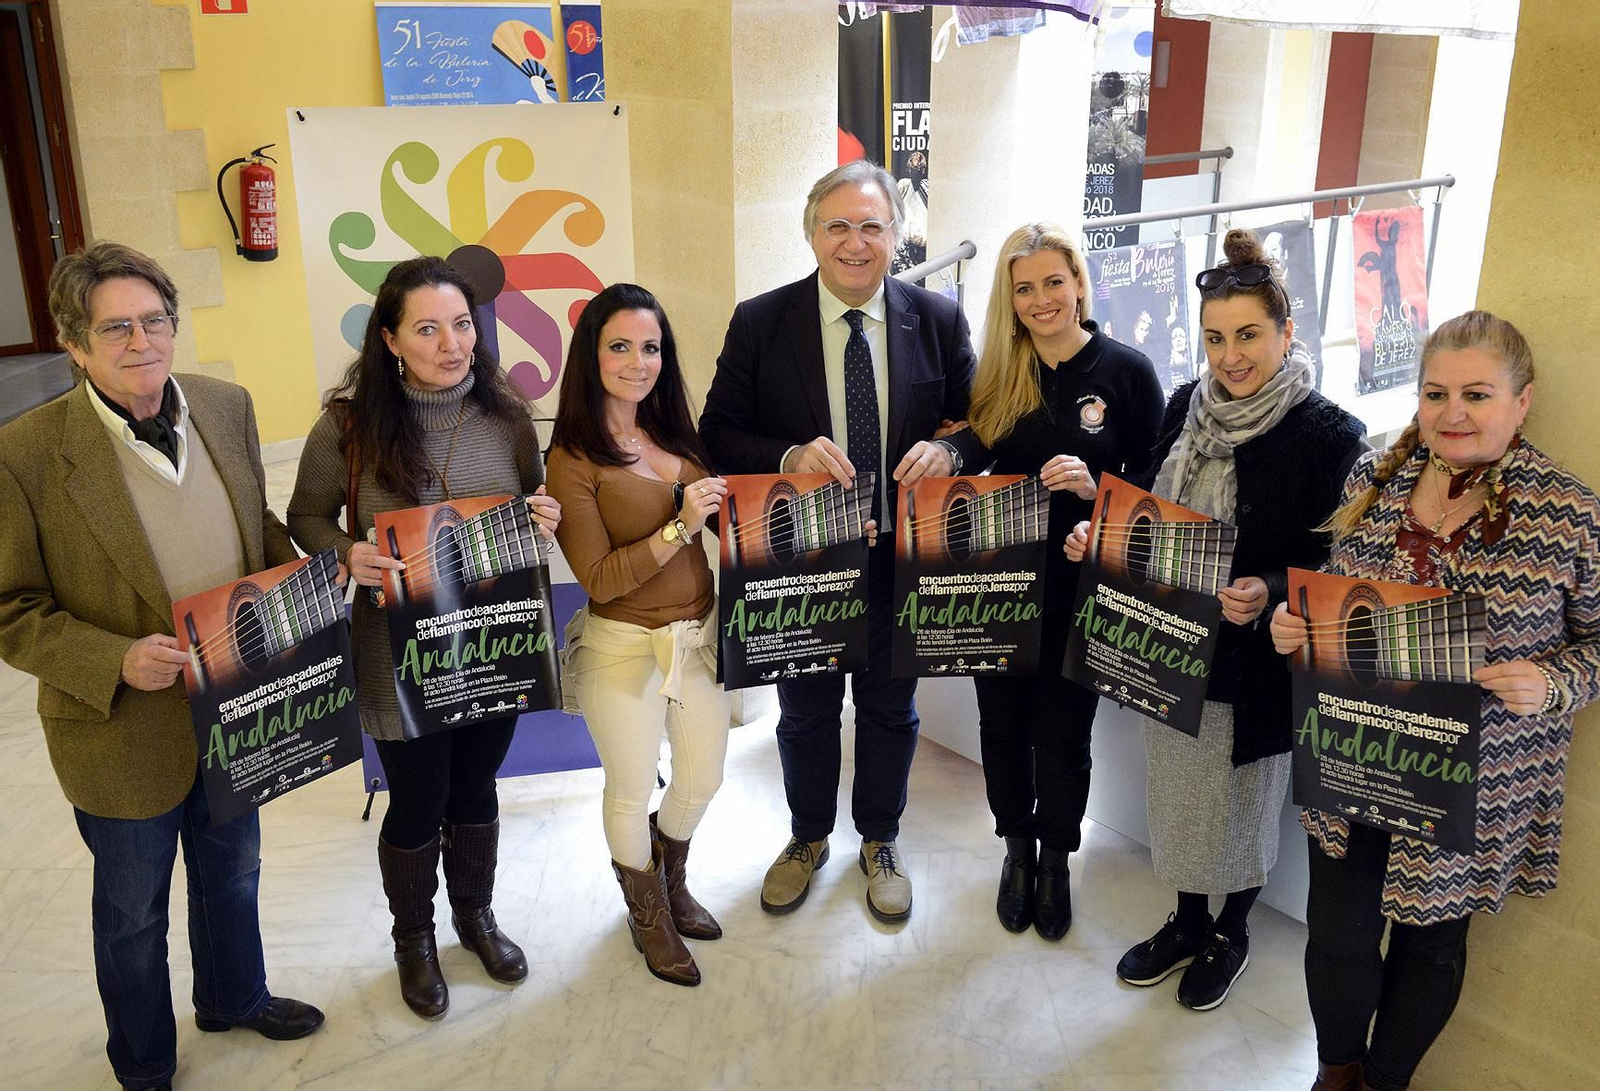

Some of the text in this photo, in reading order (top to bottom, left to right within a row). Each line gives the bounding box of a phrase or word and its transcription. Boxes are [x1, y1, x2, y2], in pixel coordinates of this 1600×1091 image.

[394, 19, 471, 54] 51 Fiesta
[570, 24, 590, 52] 51
[384, 58, 399, 67] de
[406, 57, 420, 67] la
[423, 70, 484, 87] de Jerez
[893, 111, 930, 135] FLA
[1087, 163, 1115, 174] ADAS
[1090, 176, 1114, 185] JEREZ
[1094, 186, 1113, 194] 2018
[1108, 252, 1117, 264] 52
[1097, 258, 1130, 284] fiesta
[1155, 282, 1175, 294] 2019
[1375, 346, 1415, 367] DE JEREZ
[745, 569, 860, 590] encuentrodeacademias
[919, 571, 1036, 585] encuentrodeacademias
[416, 598, 544, 629] encuentrodeacademias
[1097, 583, 1208, 636] encuentrodeacademias
[219, 654, 343, 713] encuentrodeacademias
[437, 673, 454, 681] febrero
[456, 682, 467, 690] lugar
[1318, 692, 1469, 734] encuentrodeacademias
